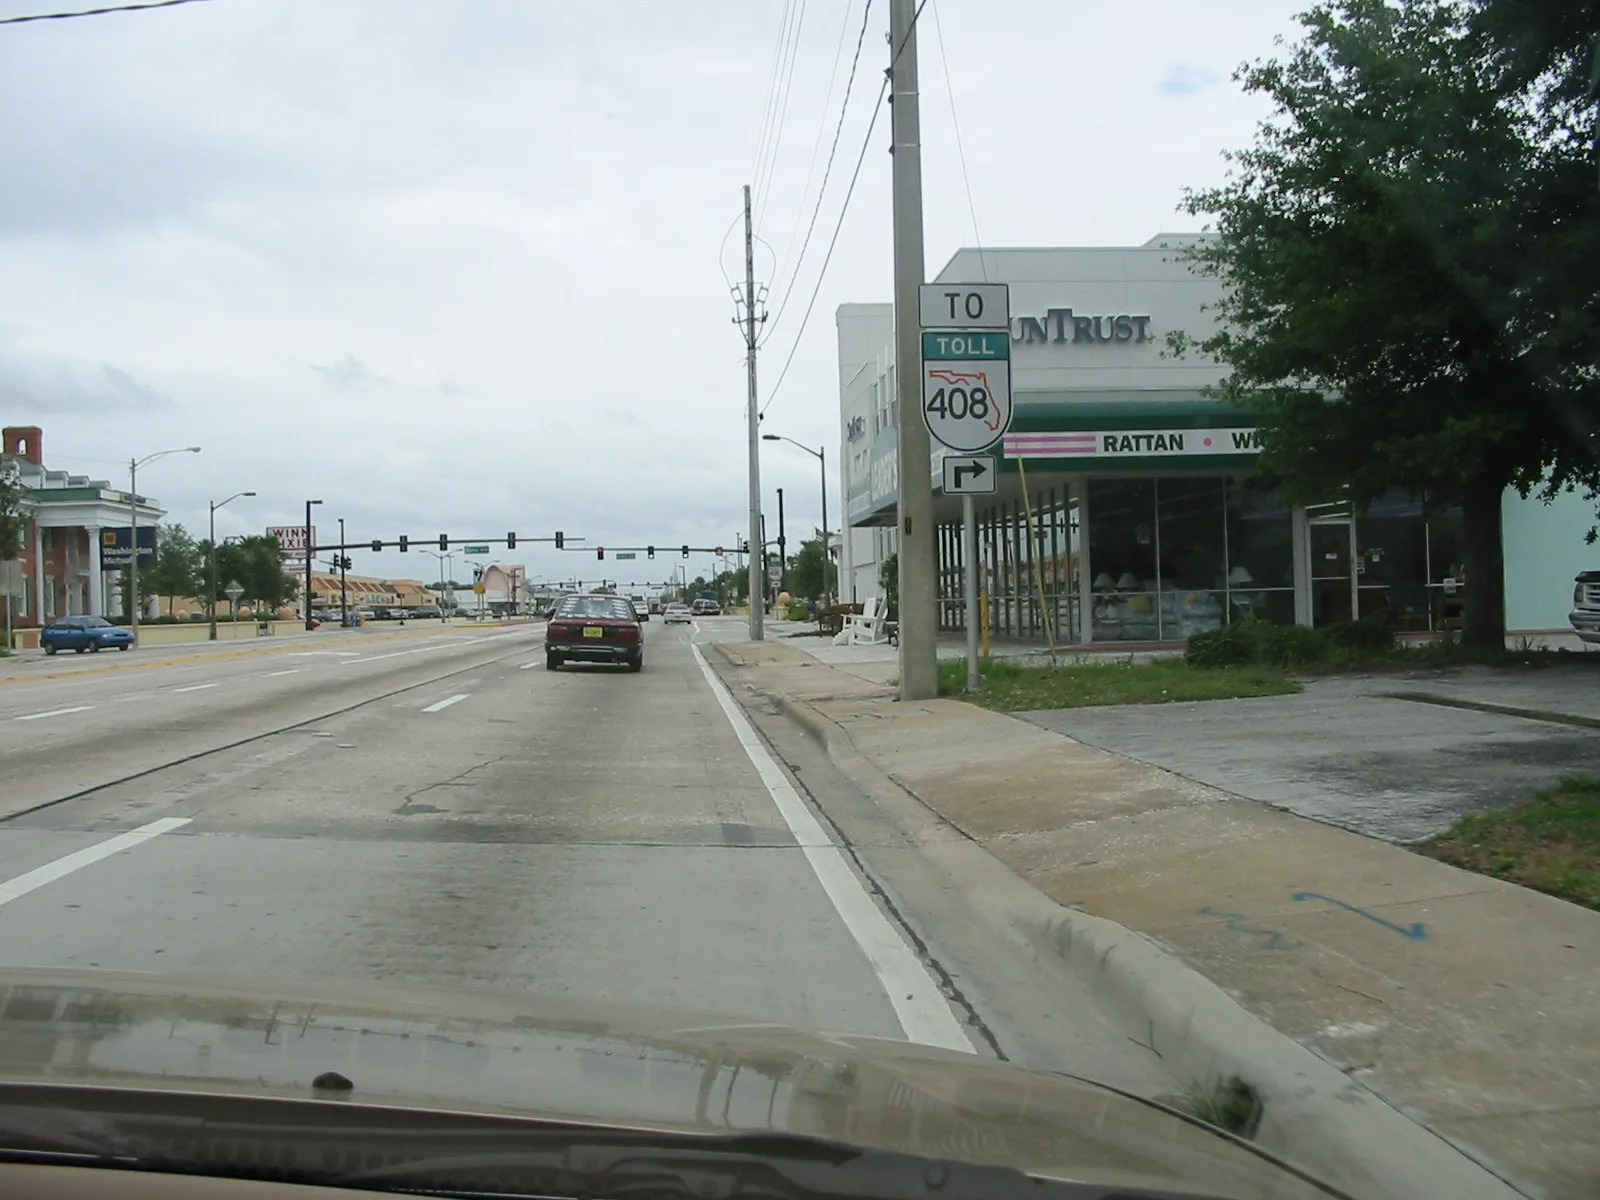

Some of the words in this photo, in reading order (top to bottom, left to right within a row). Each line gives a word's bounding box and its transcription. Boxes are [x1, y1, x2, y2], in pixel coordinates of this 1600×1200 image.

[944, 292, 984, 319] TO
[1008, 308, 1151, 342] UNTRUST
[936, 337, 995, 355] TOLL
[926, 386, 989, 420] 408
[1103, 433, 1184, 452] RATTAN
